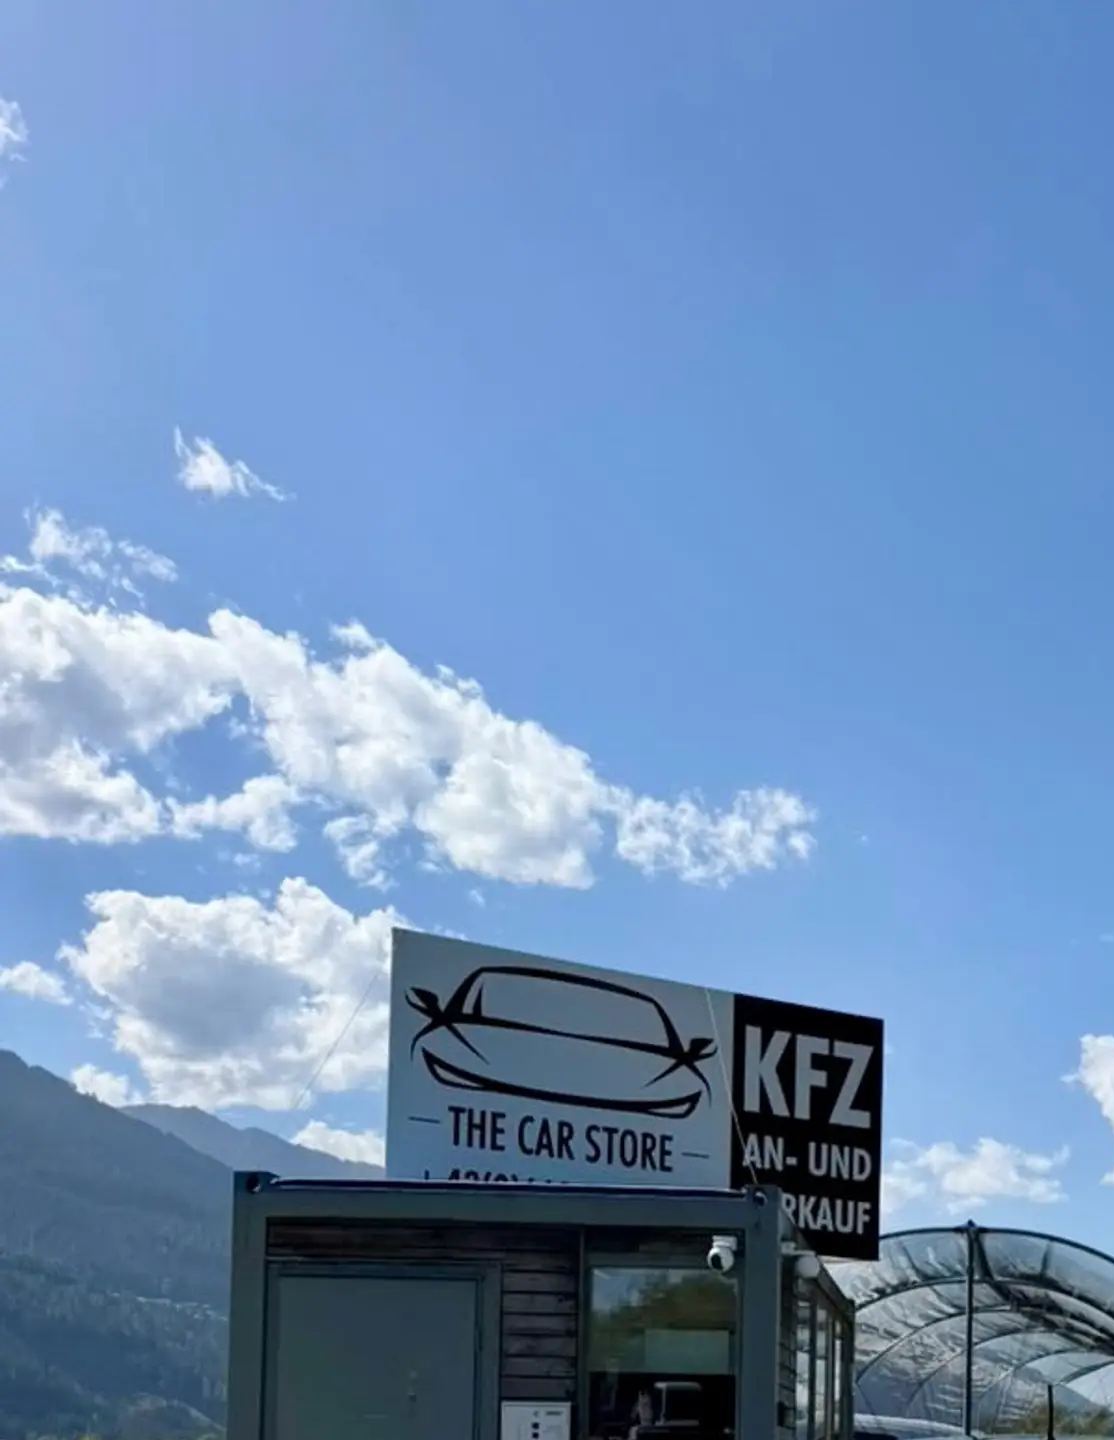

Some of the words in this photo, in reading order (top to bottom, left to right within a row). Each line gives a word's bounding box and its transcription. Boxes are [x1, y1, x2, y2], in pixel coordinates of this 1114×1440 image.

[742, 1023, 874, 1129] KFZ
[447, 1105, 506, 1151] THE
[517, 1115, 575, 1160] CAR
[585, 1124, 674, 1173] STORE
[742, 1133, 798, 1171] AN-
[808, 1141, 872, 1182] UND
[780, 1191, 871, 1235] RKAUF
